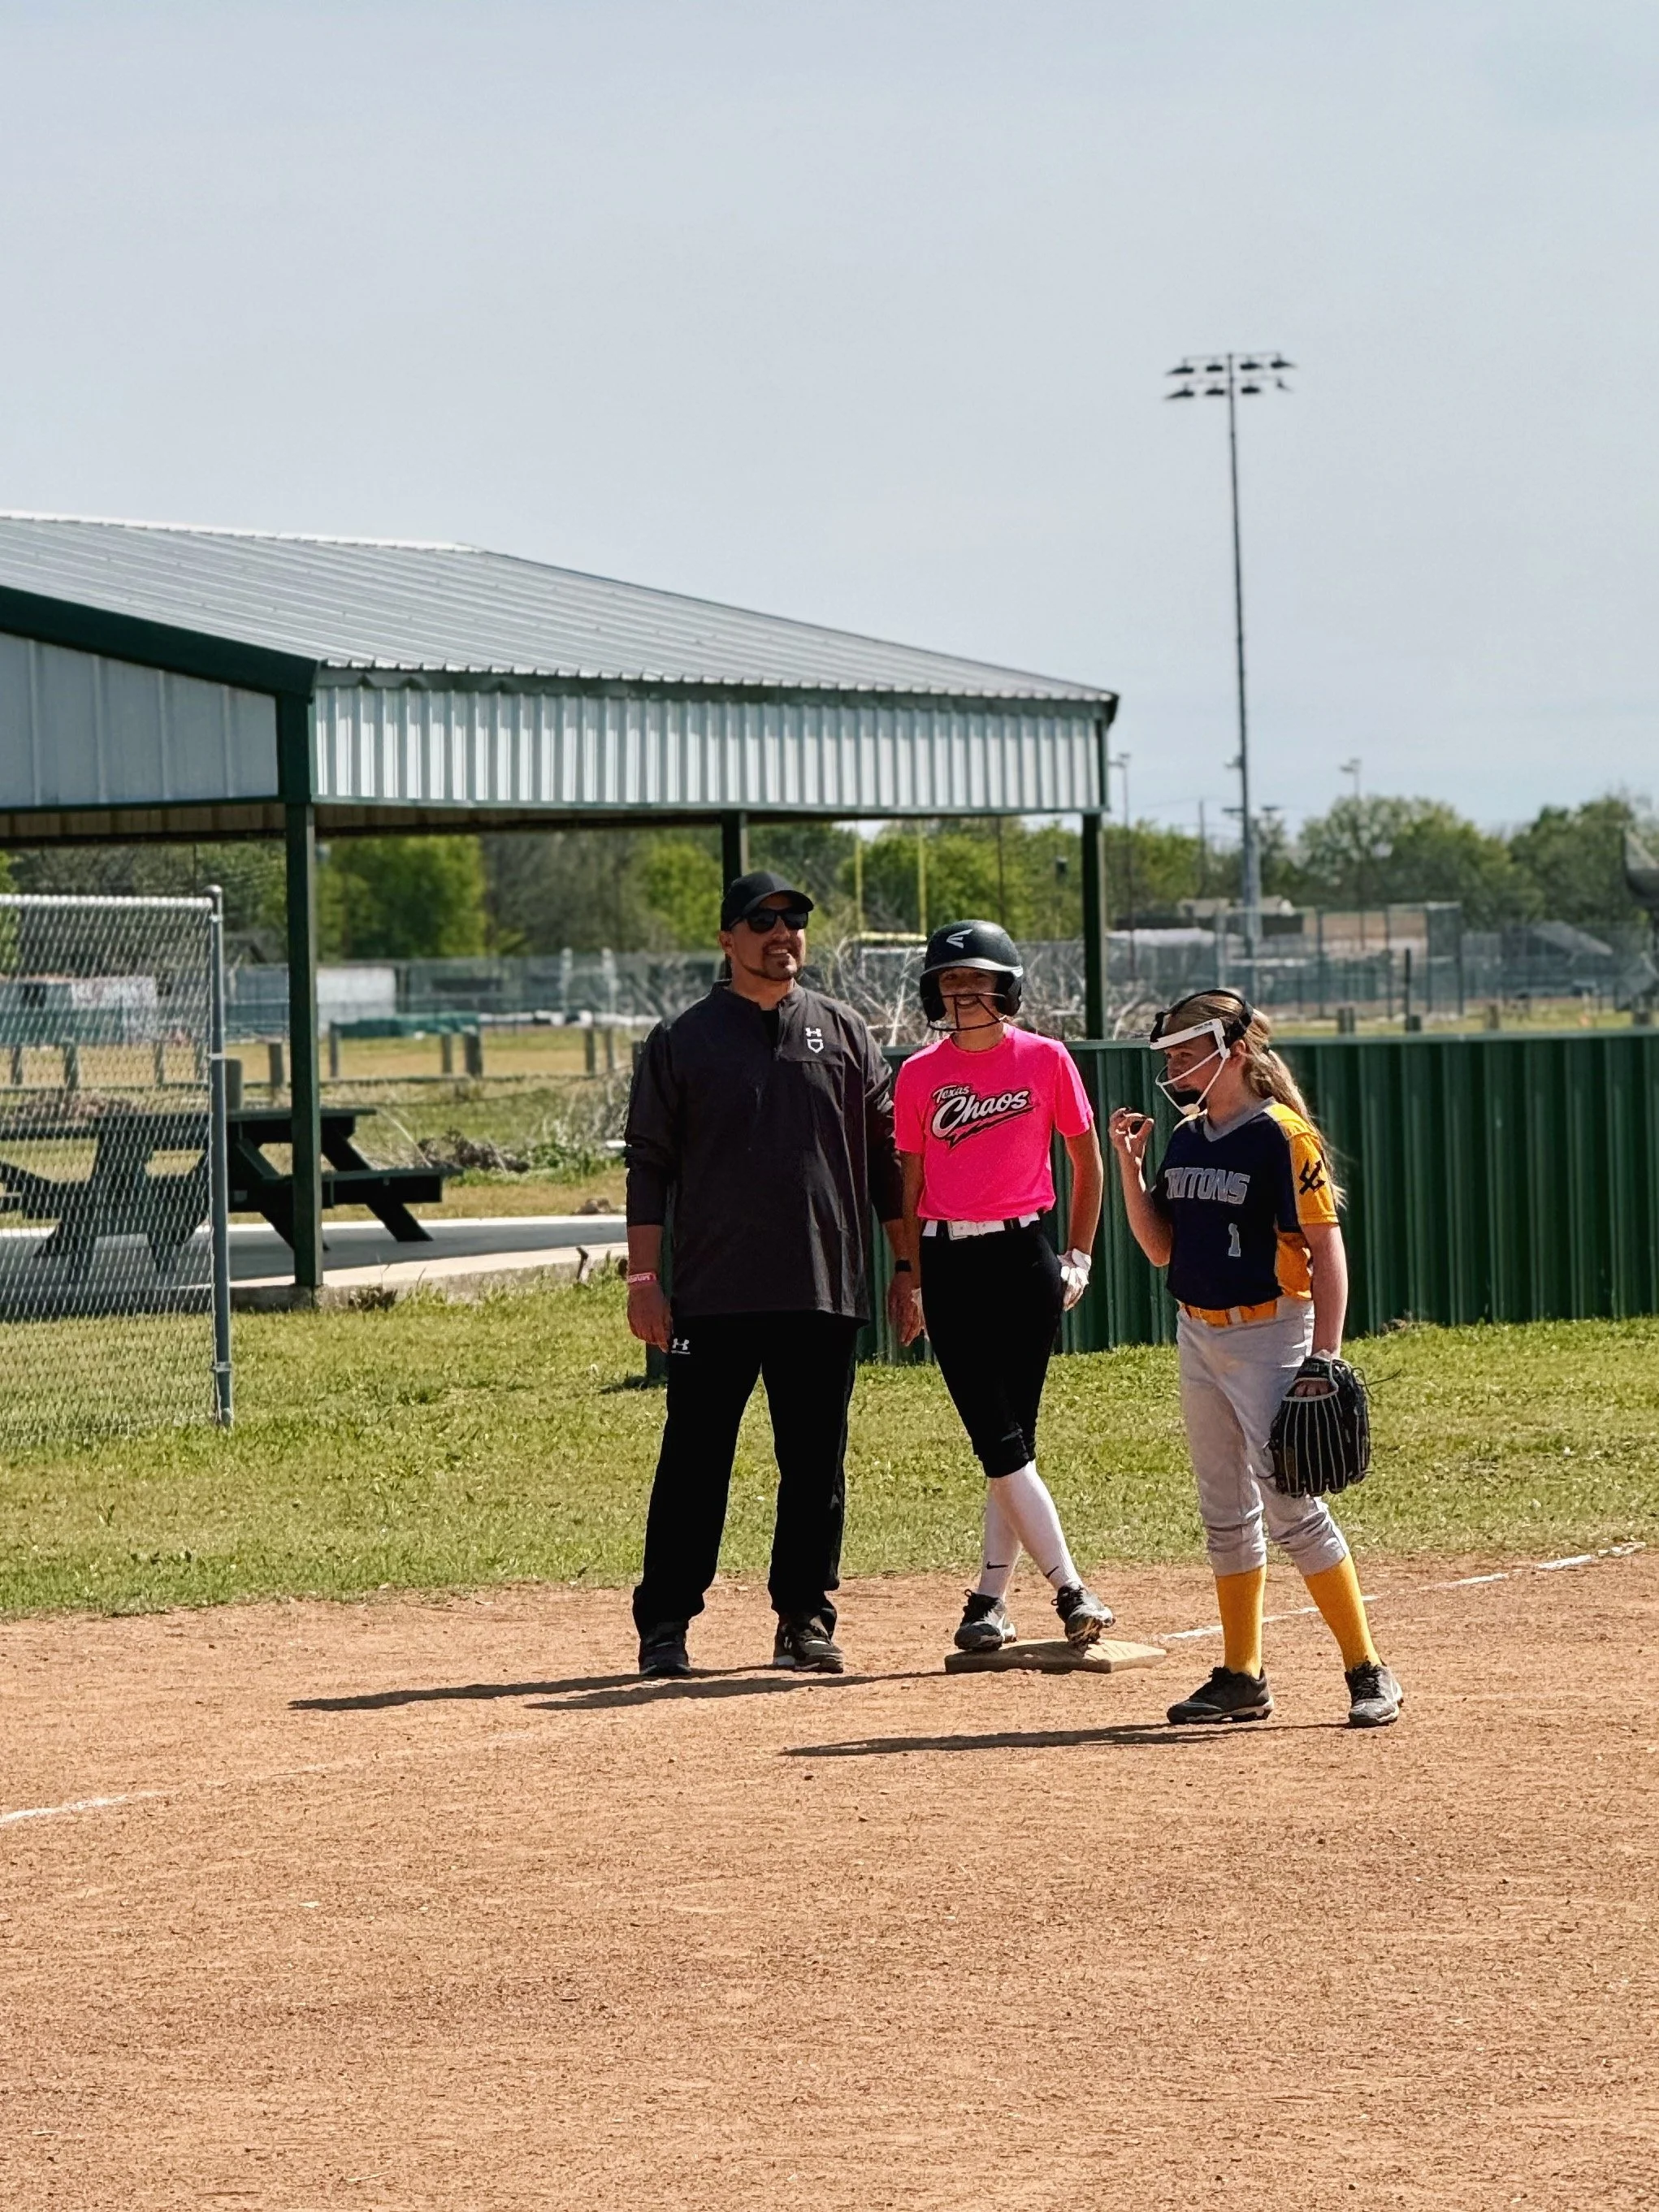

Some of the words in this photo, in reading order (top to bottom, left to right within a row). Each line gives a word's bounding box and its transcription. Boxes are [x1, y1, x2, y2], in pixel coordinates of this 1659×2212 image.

[933, 1084, 970, 1103] Texas
[932, 1090, 1029, 1138] Chaos
[1228, 1223, 1241, 1258] 1
